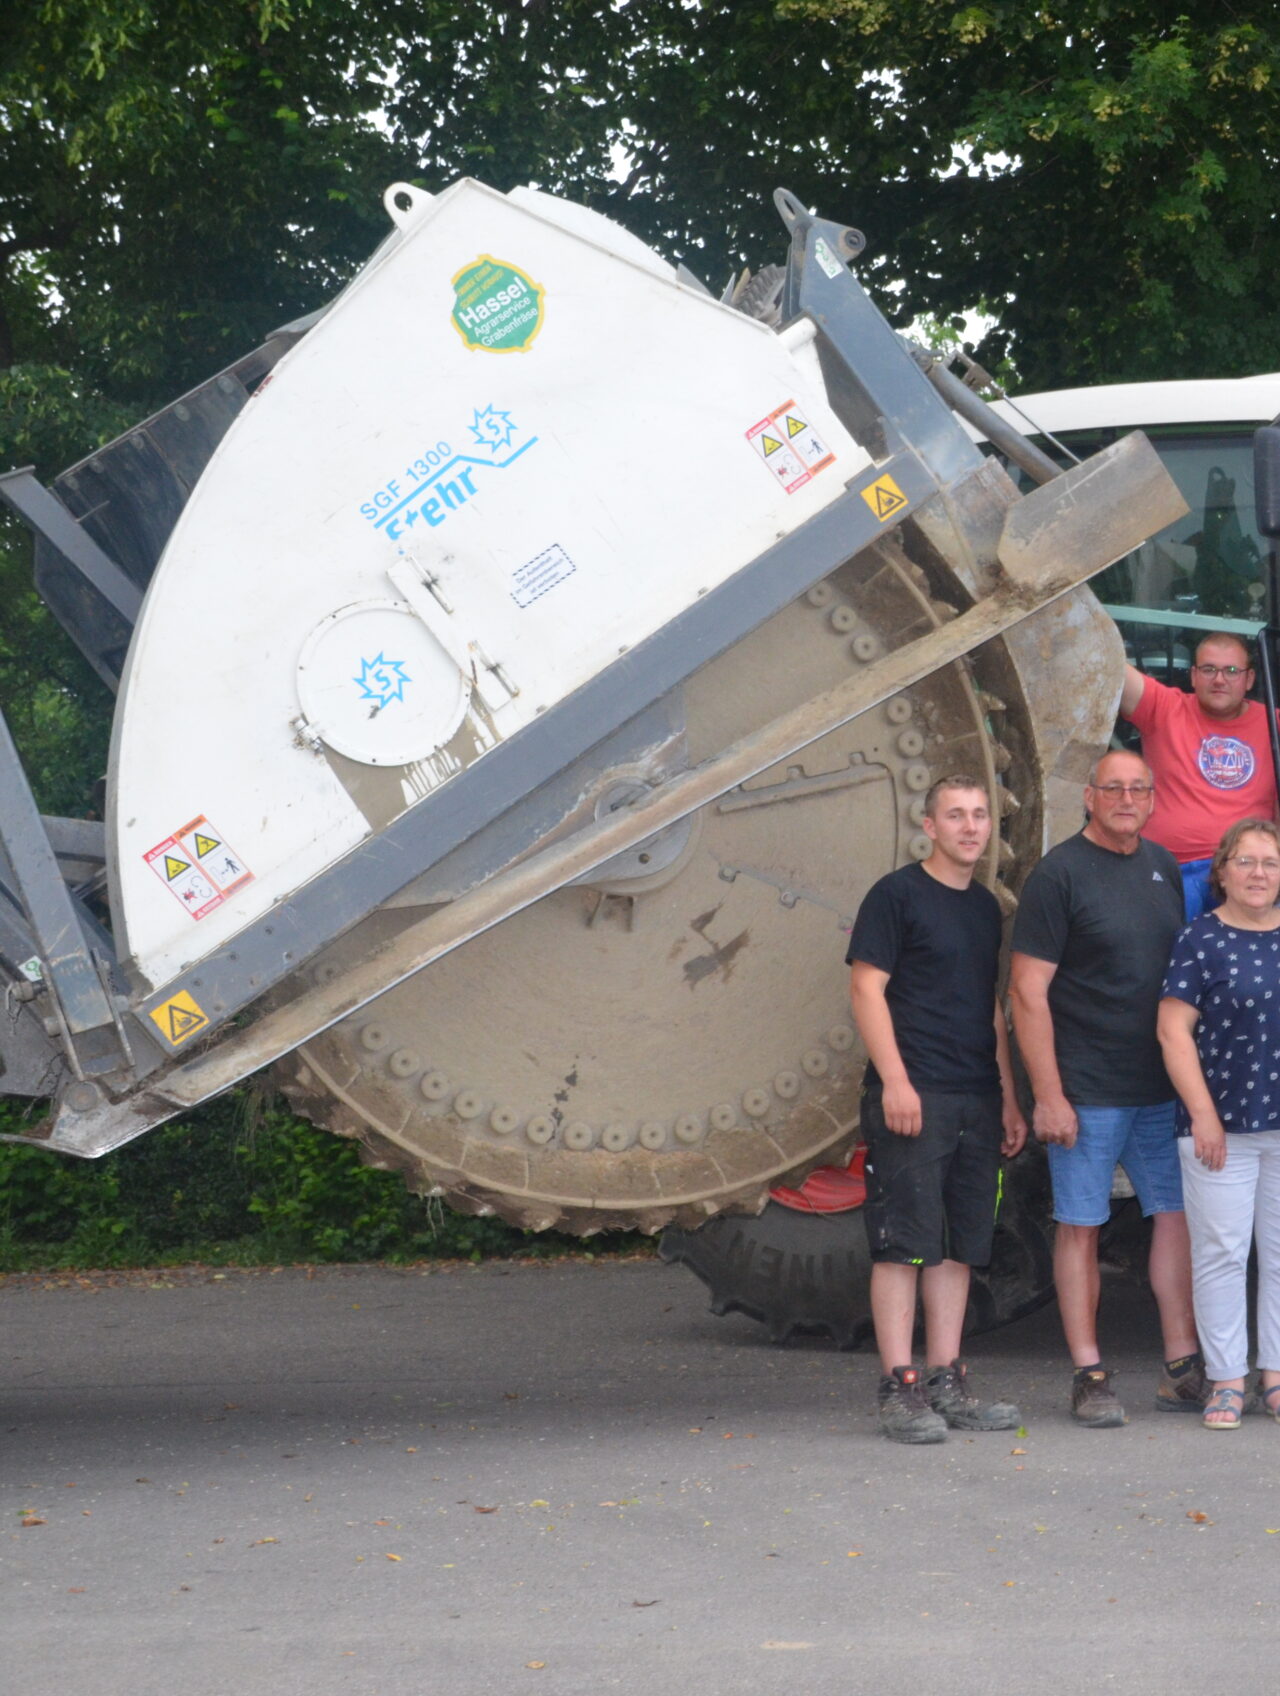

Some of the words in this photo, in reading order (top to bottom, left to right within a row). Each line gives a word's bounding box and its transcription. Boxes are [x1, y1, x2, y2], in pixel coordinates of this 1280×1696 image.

[458, 276, 527, 329] Hassel
[474, 297, 531, 338] Agrarservice
[481, 308, 538, 347] Grabenfräse
[360, 479, 402, 521] SGF
[405, 441, 453, 482] 1300
